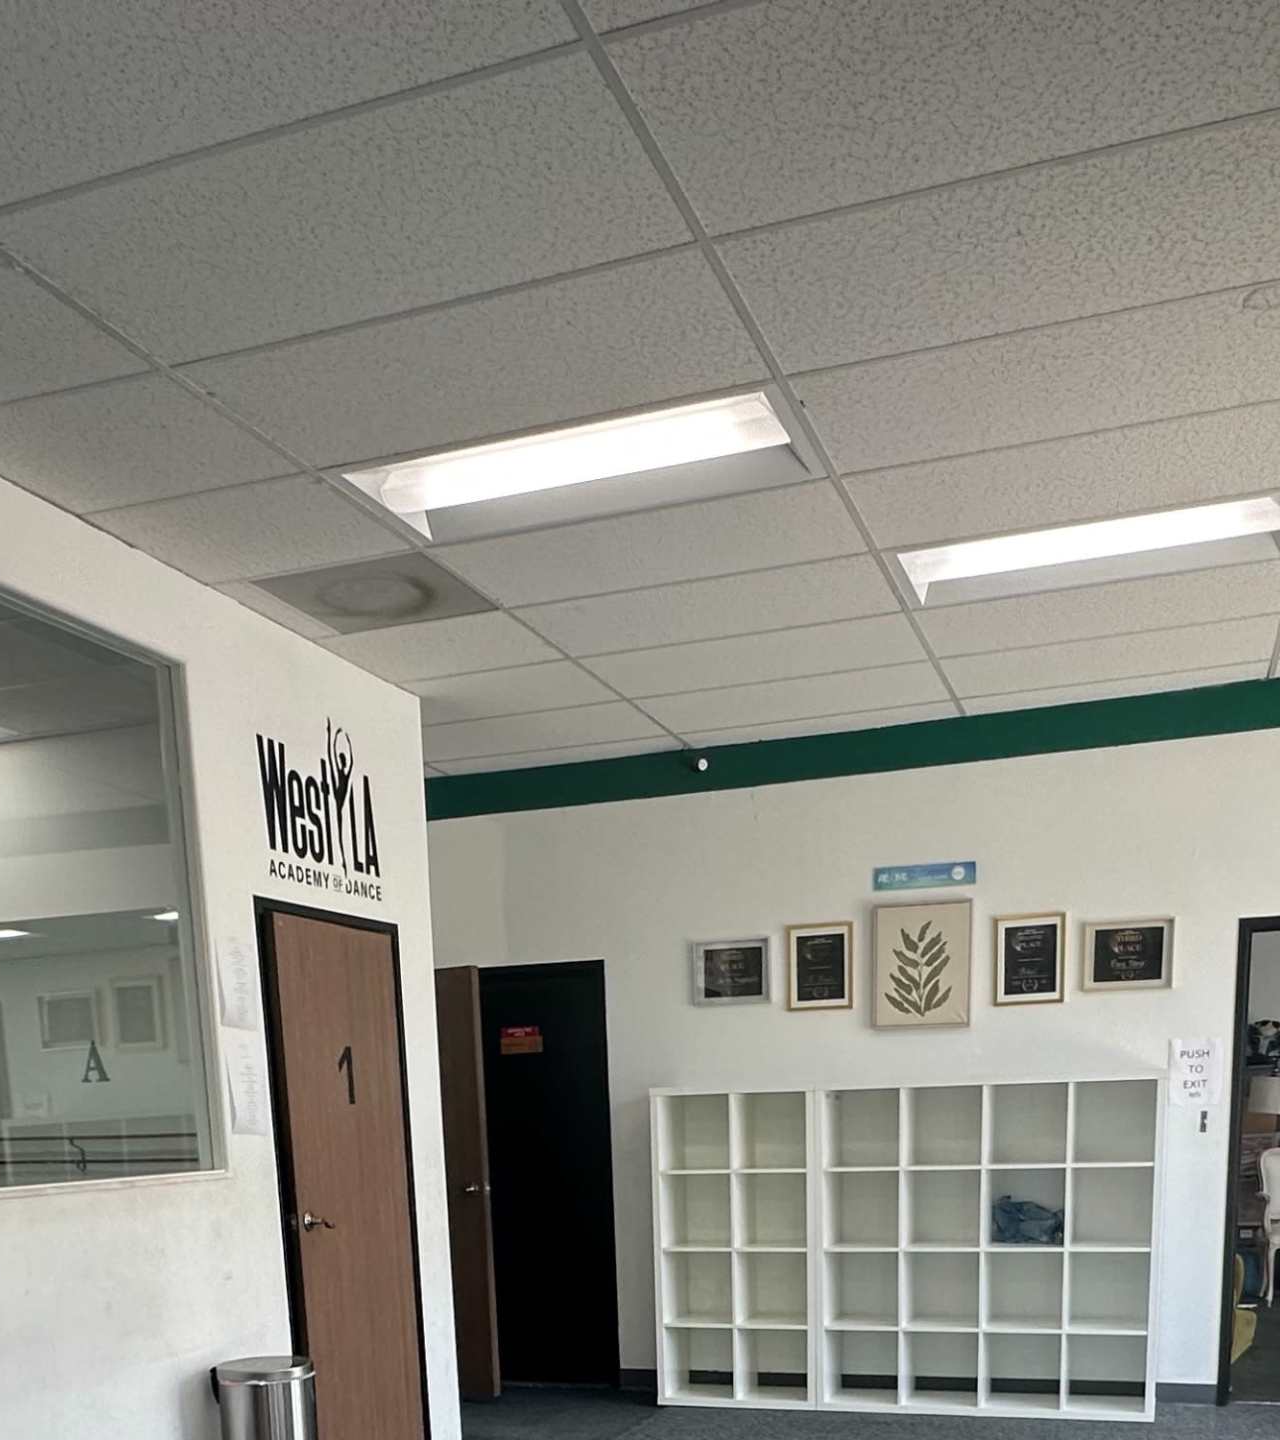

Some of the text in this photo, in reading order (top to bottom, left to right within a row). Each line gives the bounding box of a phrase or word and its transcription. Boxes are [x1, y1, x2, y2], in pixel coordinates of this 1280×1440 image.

[256, 733, 380, 877] West LA
[270, 859, 329, 888] ACADEMY
[345, 880, 382, 901] DANCE
[1179, 1049, 1210, 1059] PUSH
[338, 1046, 356, 1105] 1
[1188, 1064, 1204, 1074] TO
[1183, 1079, 1208, 1089] EXIT
